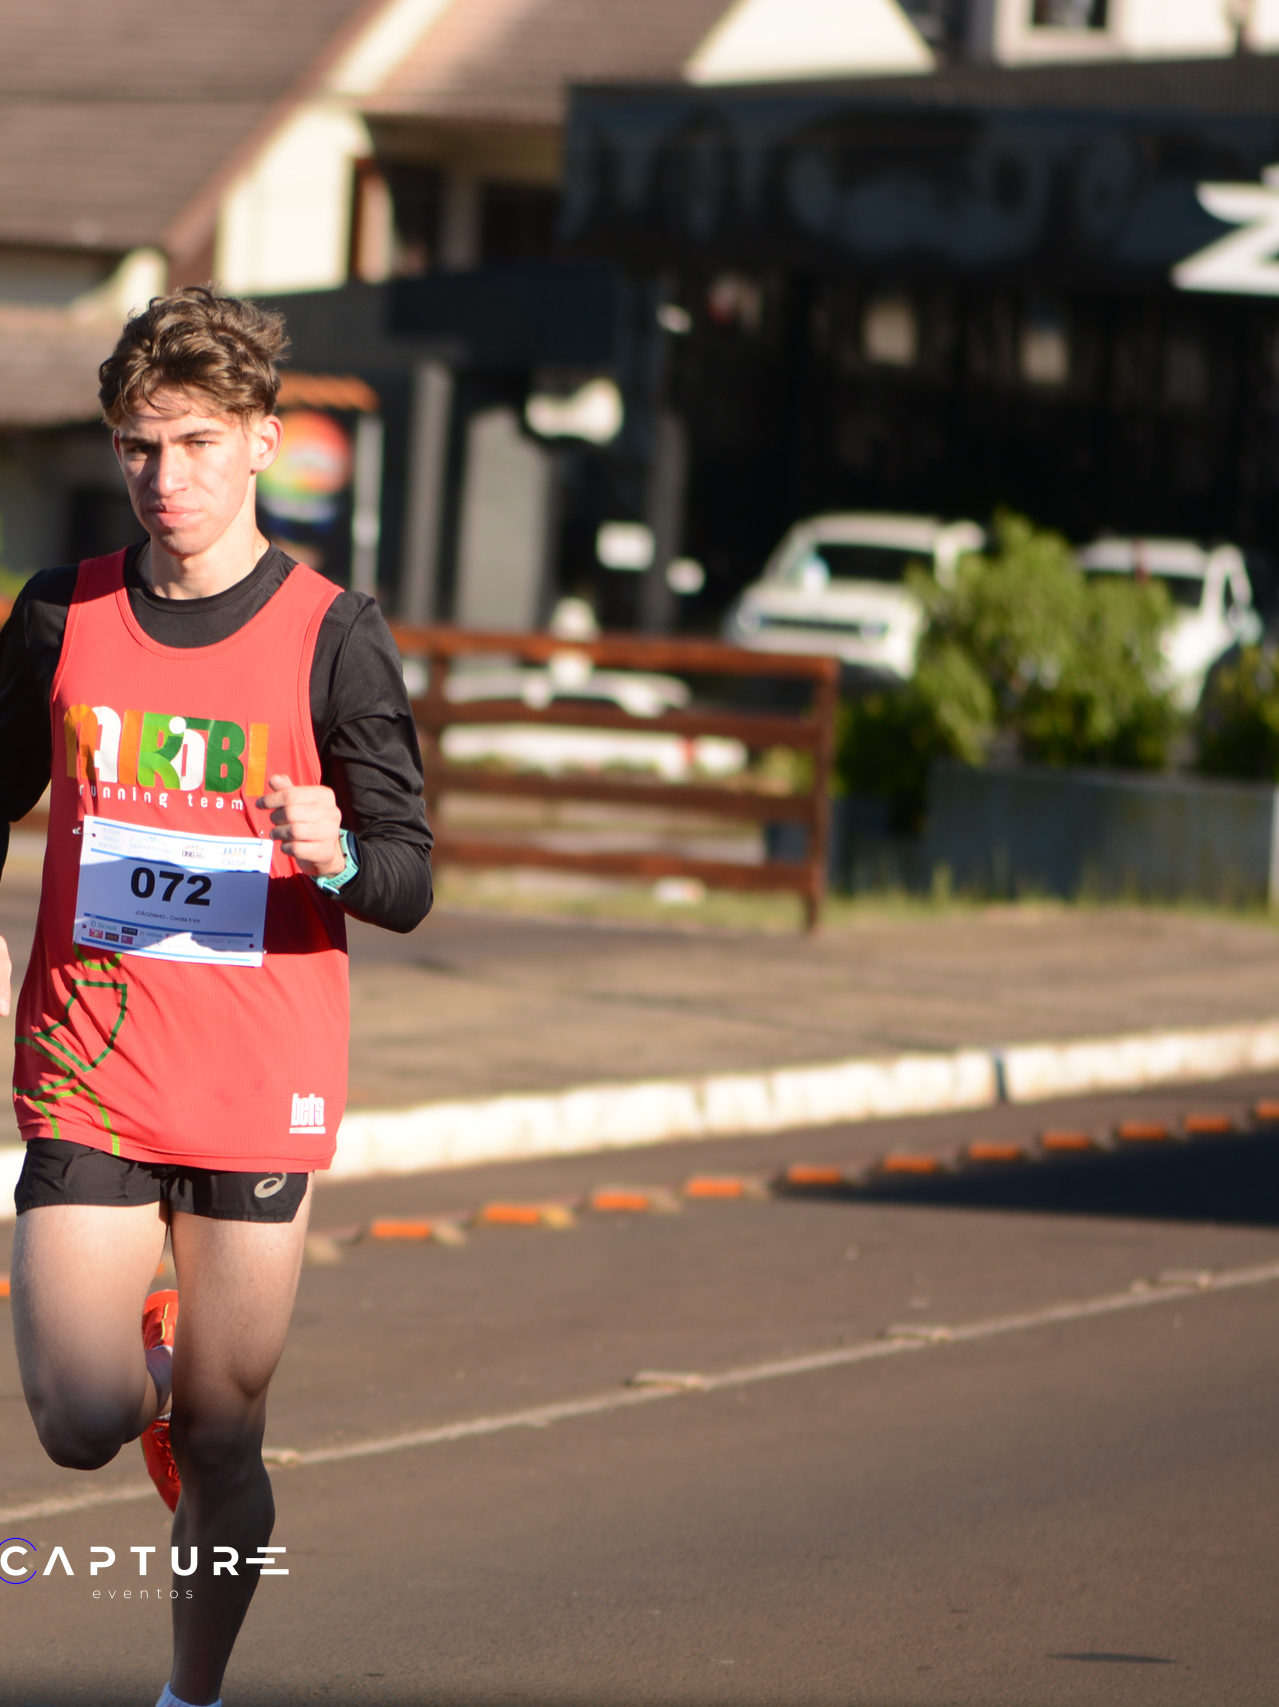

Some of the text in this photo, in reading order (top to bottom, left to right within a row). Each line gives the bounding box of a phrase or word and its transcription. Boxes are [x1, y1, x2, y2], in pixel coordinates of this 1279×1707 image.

[79, 784, 244, 811] running team
[130, 867, 212, 906] 072
[98, 922, 117, 931] Sicredi
[169, 915, 187, 923] Corrida
